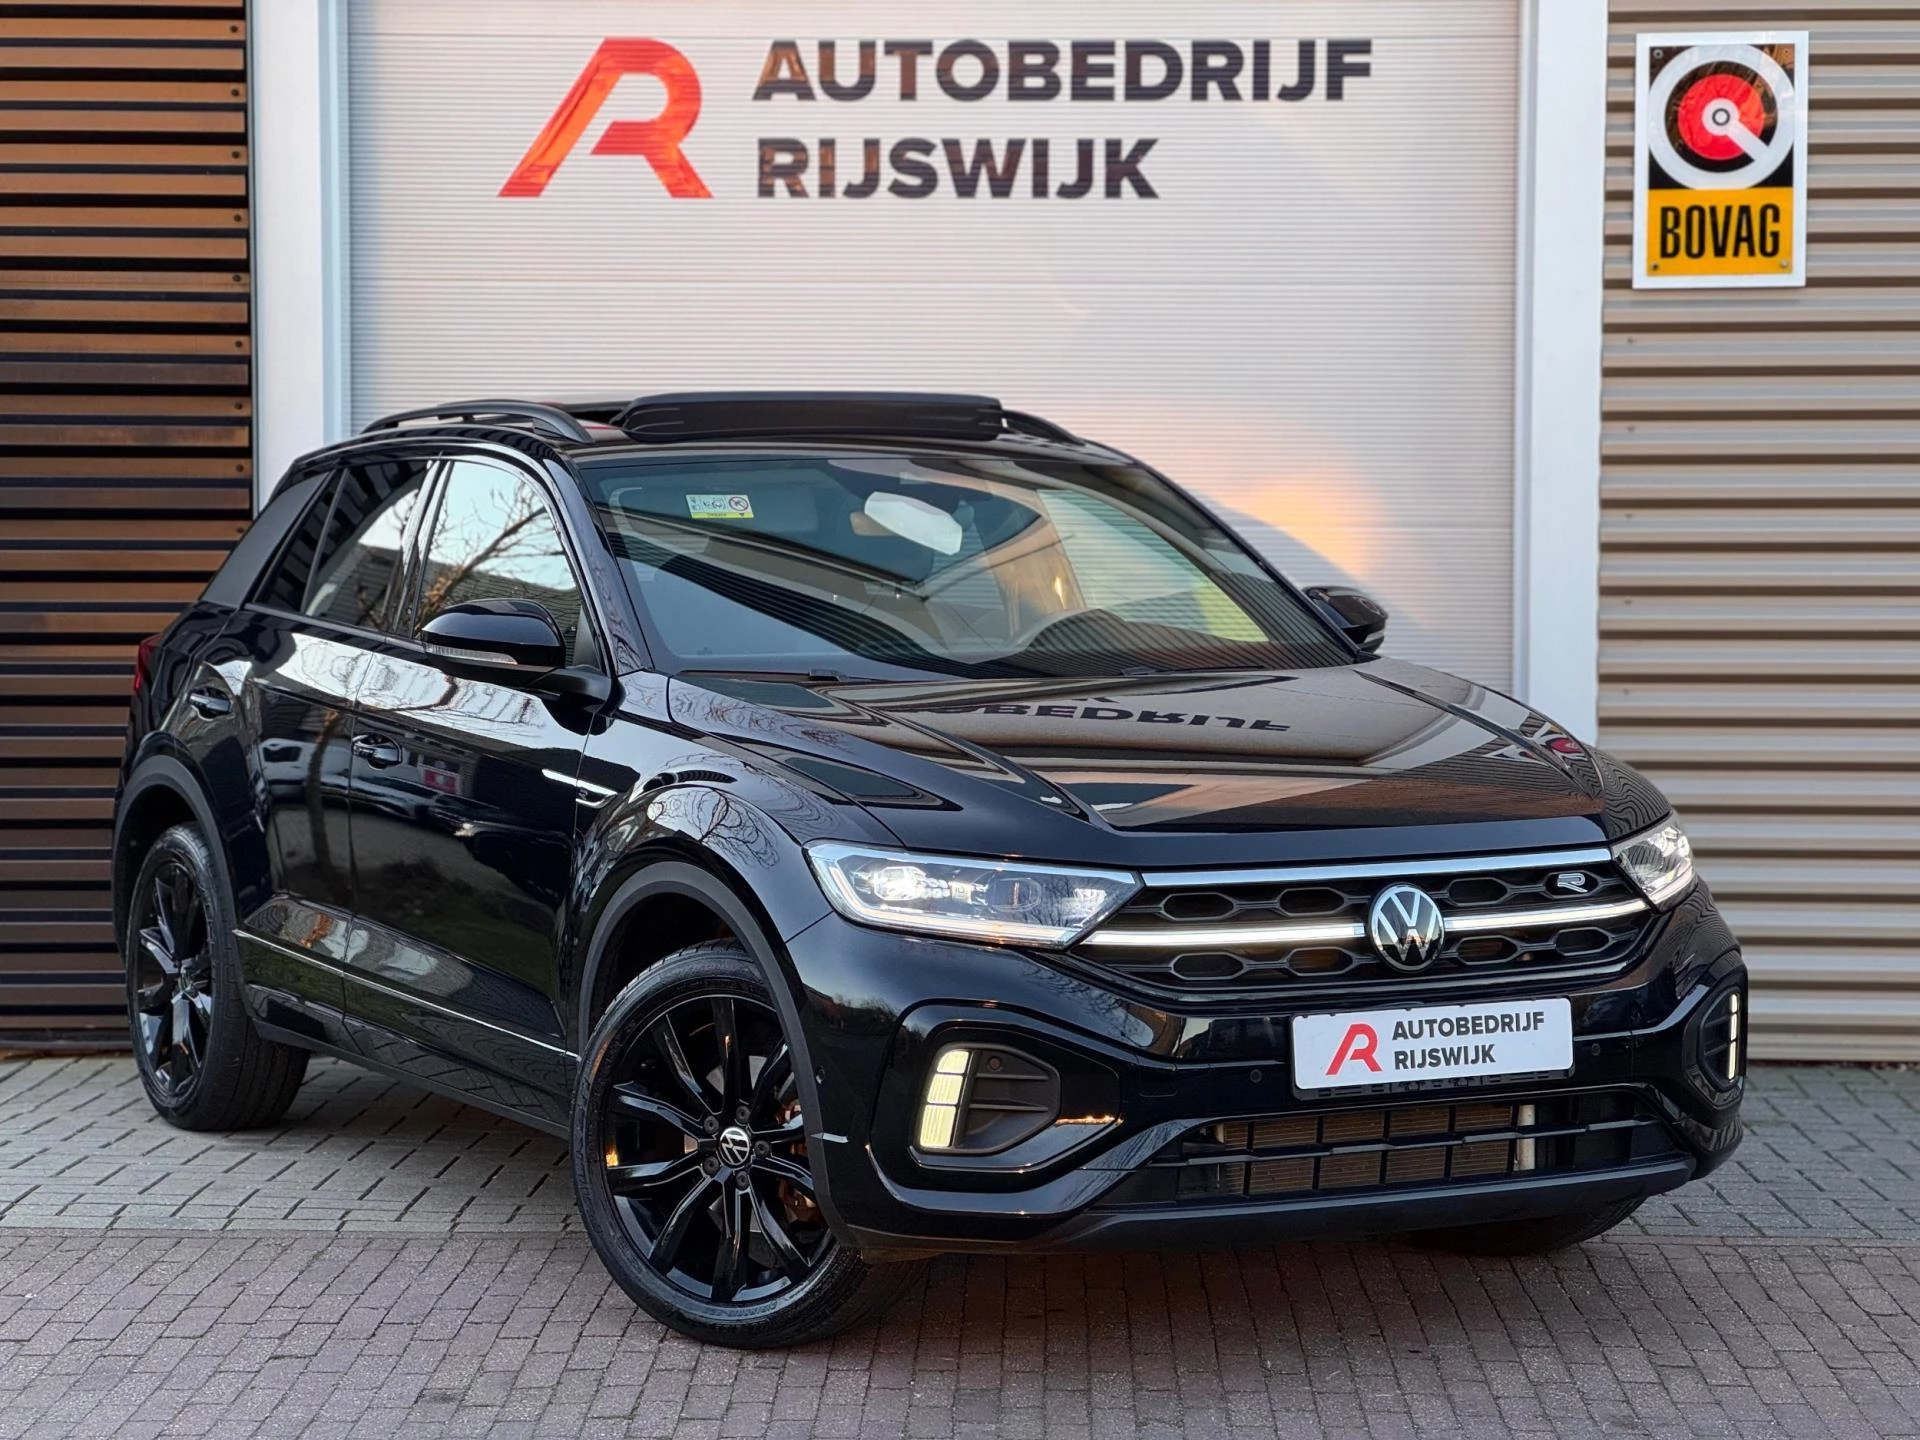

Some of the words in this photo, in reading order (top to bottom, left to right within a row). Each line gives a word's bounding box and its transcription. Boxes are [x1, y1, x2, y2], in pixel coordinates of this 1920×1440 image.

[753, 39, 1372, 102] AUTOBEDRIJF
[757, 138, 1159, 199] RIJSWIJK
[1660, 204, 1780, 258] BOVAG
[1557, 872, 1588, 893] R
[1392, 1011, 1545, 1041] AUTOBEDRIJF
[1394, 1044, 1496, 1071] RIJSWIJK
